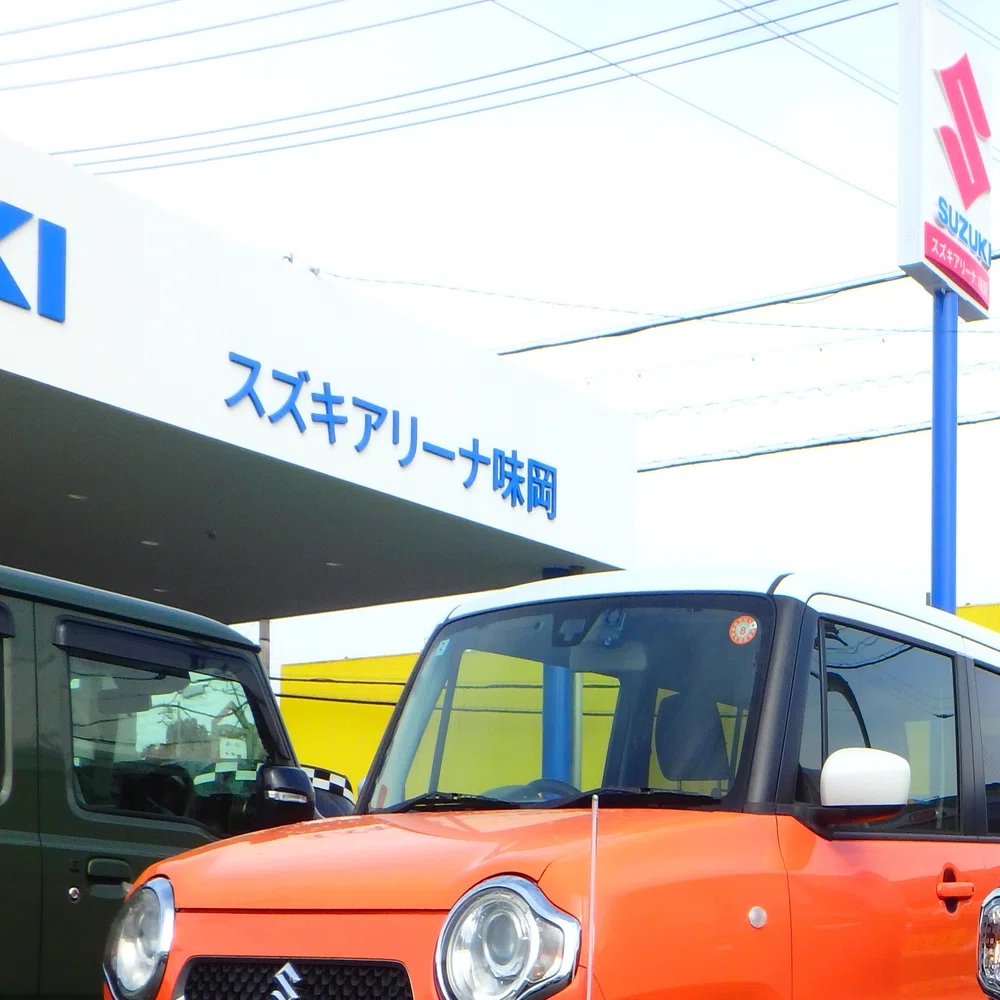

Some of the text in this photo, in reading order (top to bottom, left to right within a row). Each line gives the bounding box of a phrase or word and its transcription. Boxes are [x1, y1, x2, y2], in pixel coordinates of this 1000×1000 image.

[937, 195, 992, 270] SUZUKI
[225, 351, 558, 520] スズキアリーナ味岡
